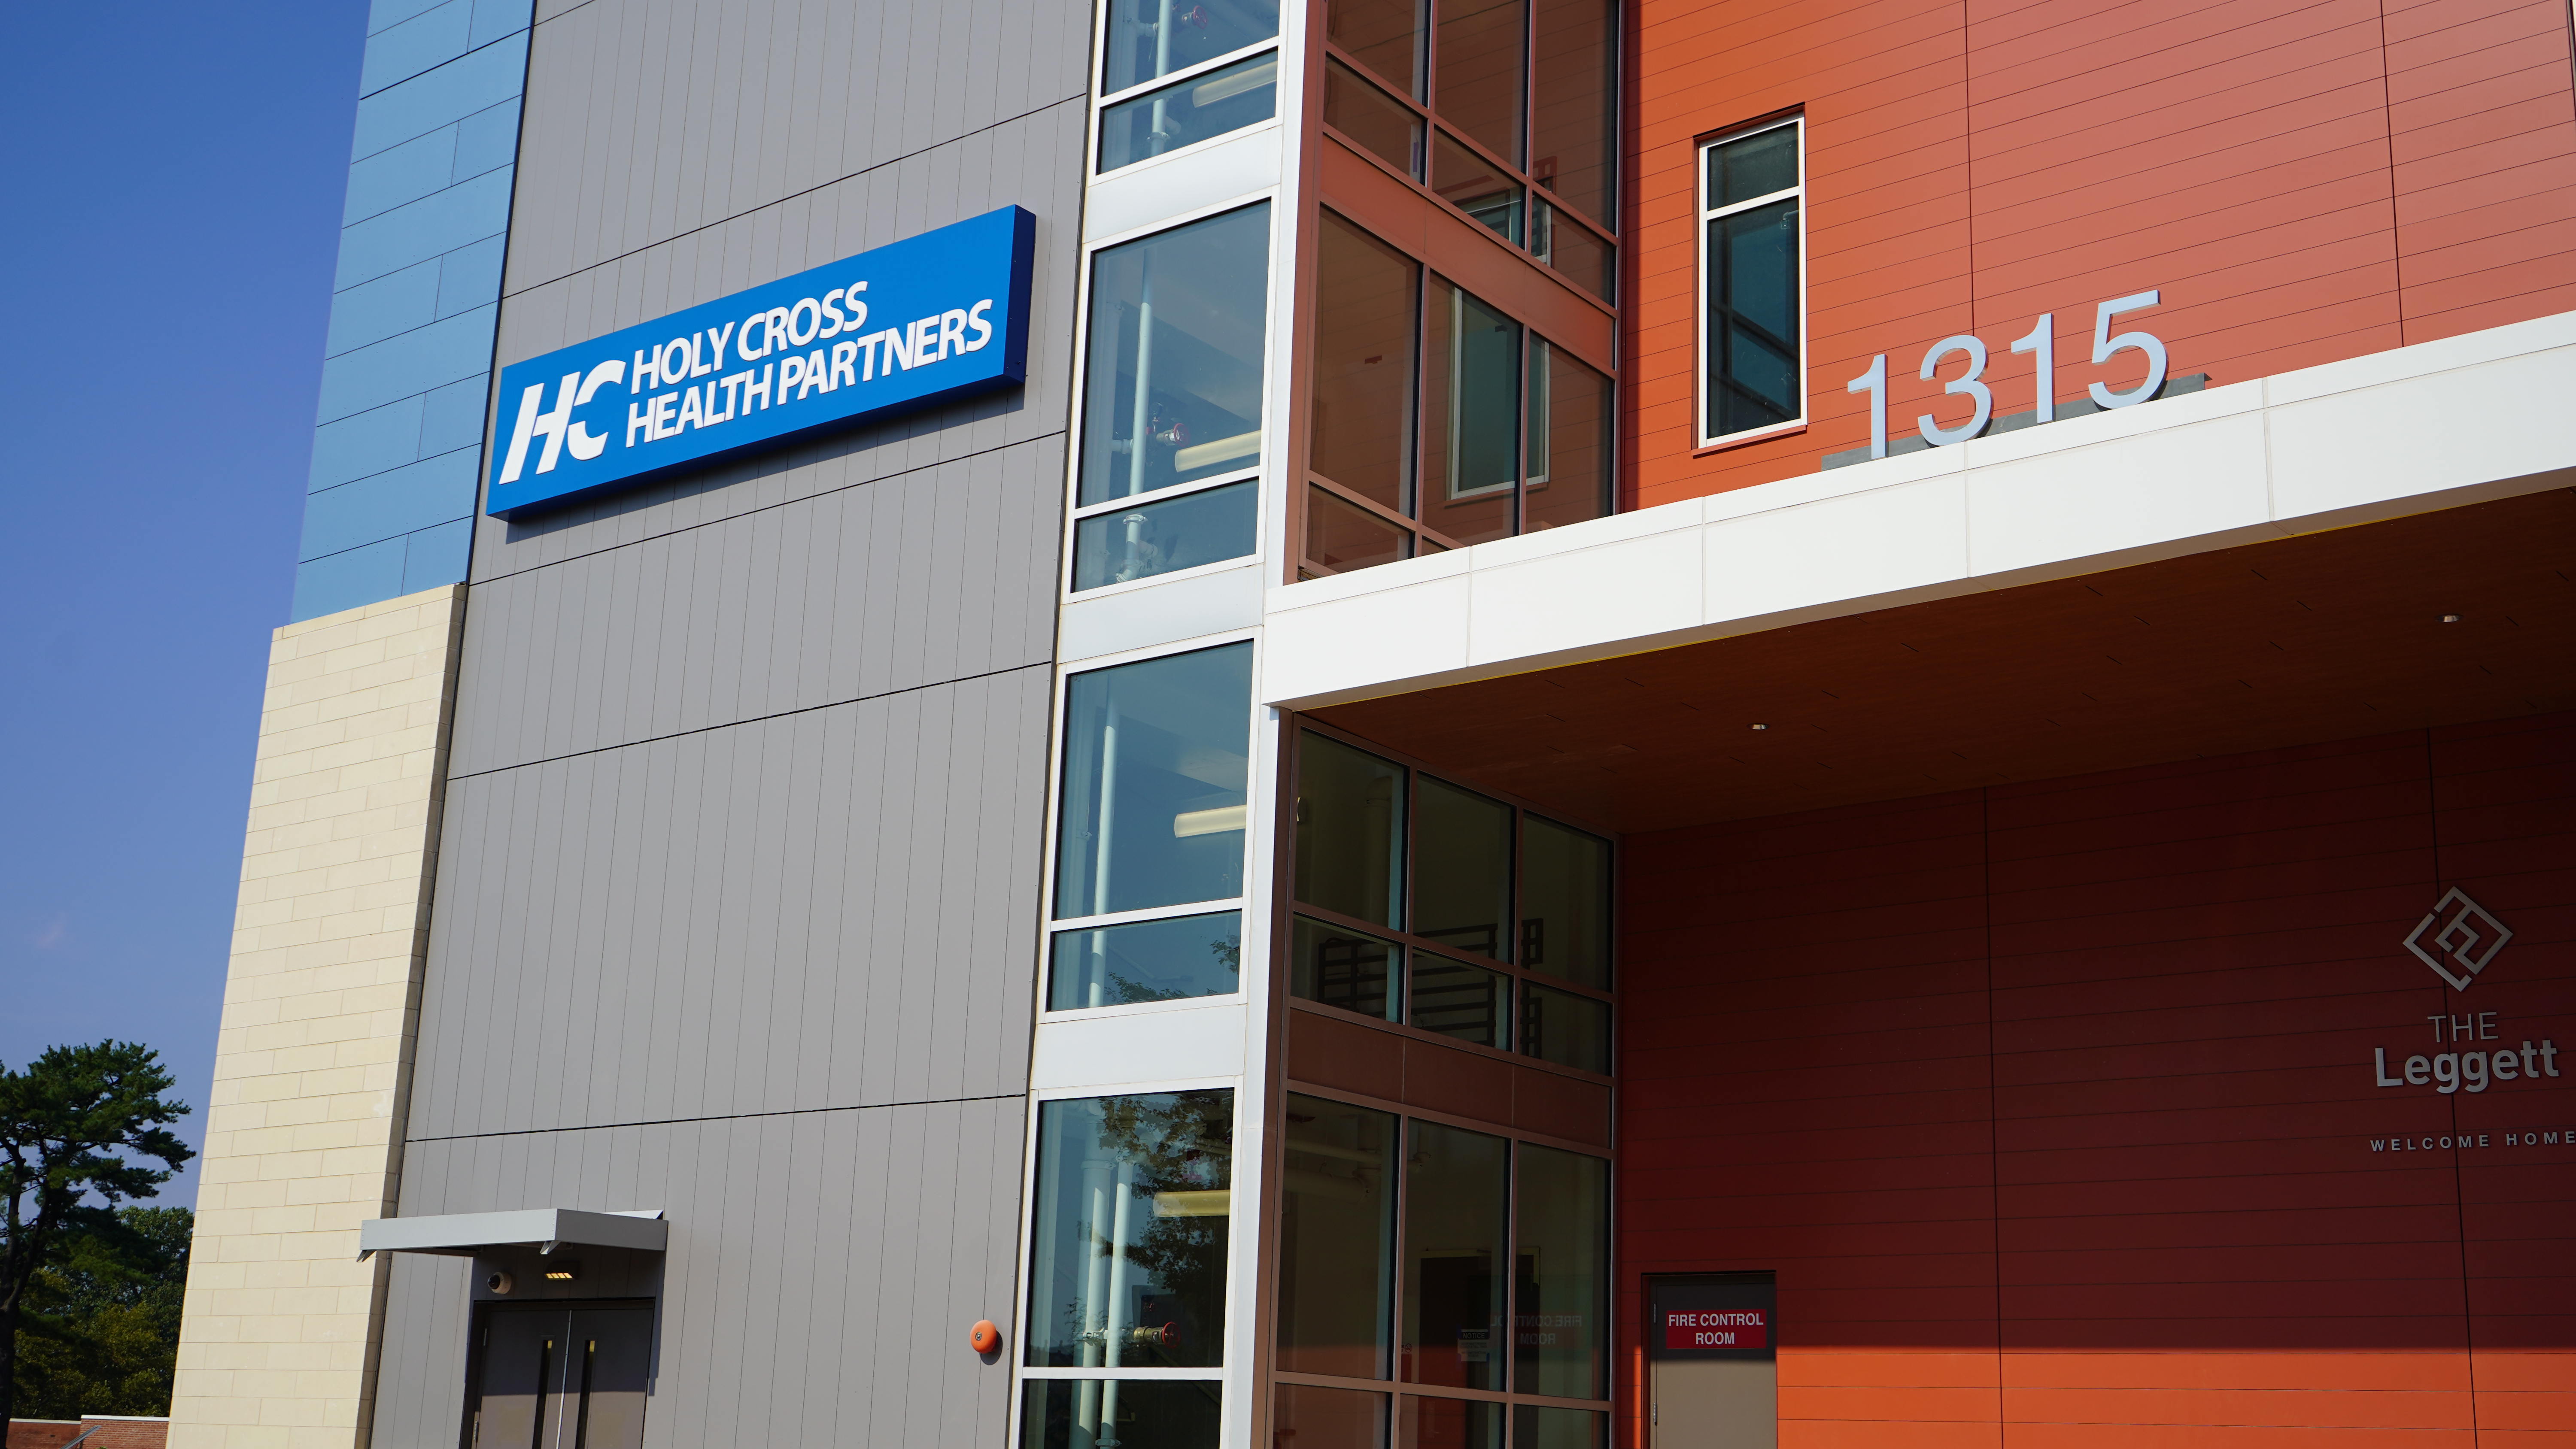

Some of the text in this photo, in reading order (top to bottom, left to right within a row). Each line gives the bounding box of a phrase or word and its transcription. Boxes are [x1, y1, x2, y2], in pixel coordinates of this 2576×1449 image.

[630, 280, 869, 395] HOLY CROSS
[626, 298, 993, 448] HEALTH PARTNERS
[1847, 289, 2169, 460] 1315
[498, 359, 626, 485] HC
[2427, 1012, 2499, 1043] THE
[2375, 1040, 2559, 1094] Leggett
[2369, 1131, 2576, 1152] WELCOME HOME
[1668, 1313, 1764, 1327] FIRE CONTROL
[1695, 1332, 1735, 1345] ROOM
